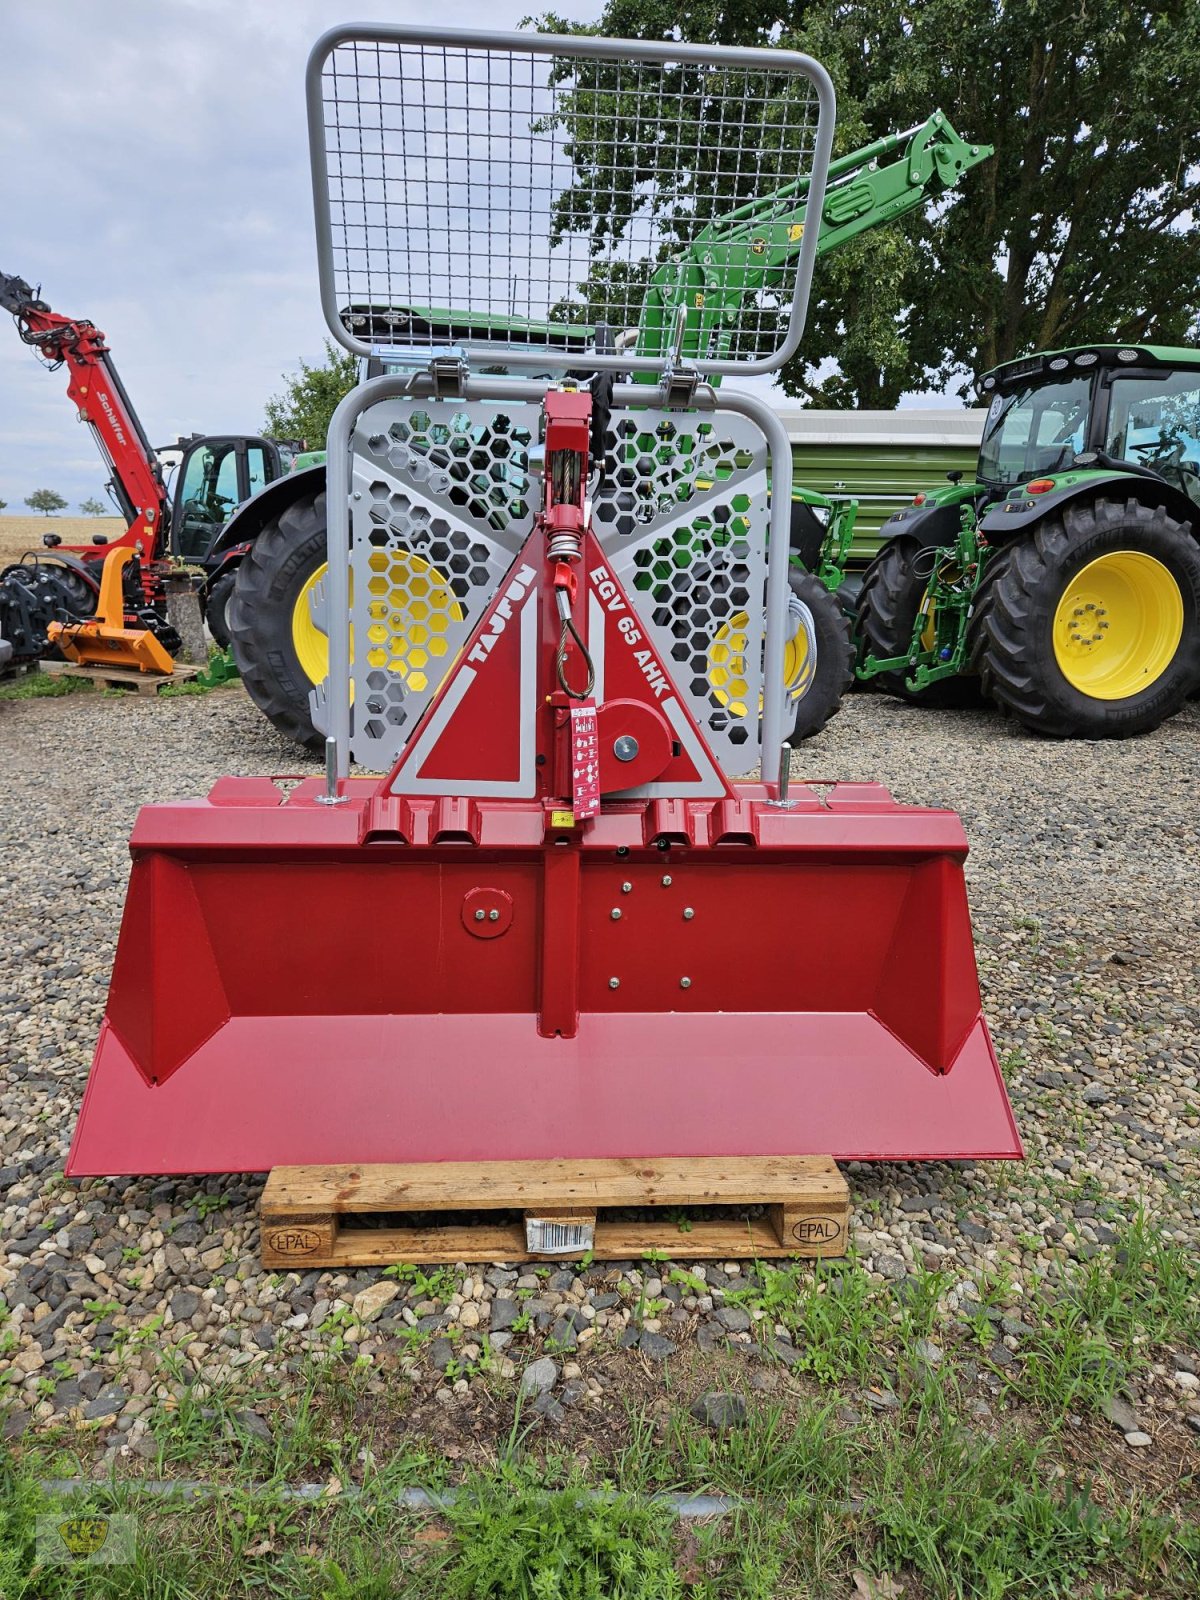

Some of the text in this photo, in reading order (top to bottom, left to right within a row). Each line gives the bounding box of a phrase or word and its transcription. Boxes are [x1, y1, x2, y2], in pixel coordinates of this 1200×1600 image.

[96, 391, 127, 446] Schäffer
[467, 563, 537, 663] TAJFUN
[589, 565, 670, 698] EGV 65 AHK
[276, 1234, 314, 1249] EPAL
[799, 1223, 833, 1238] EPAL
